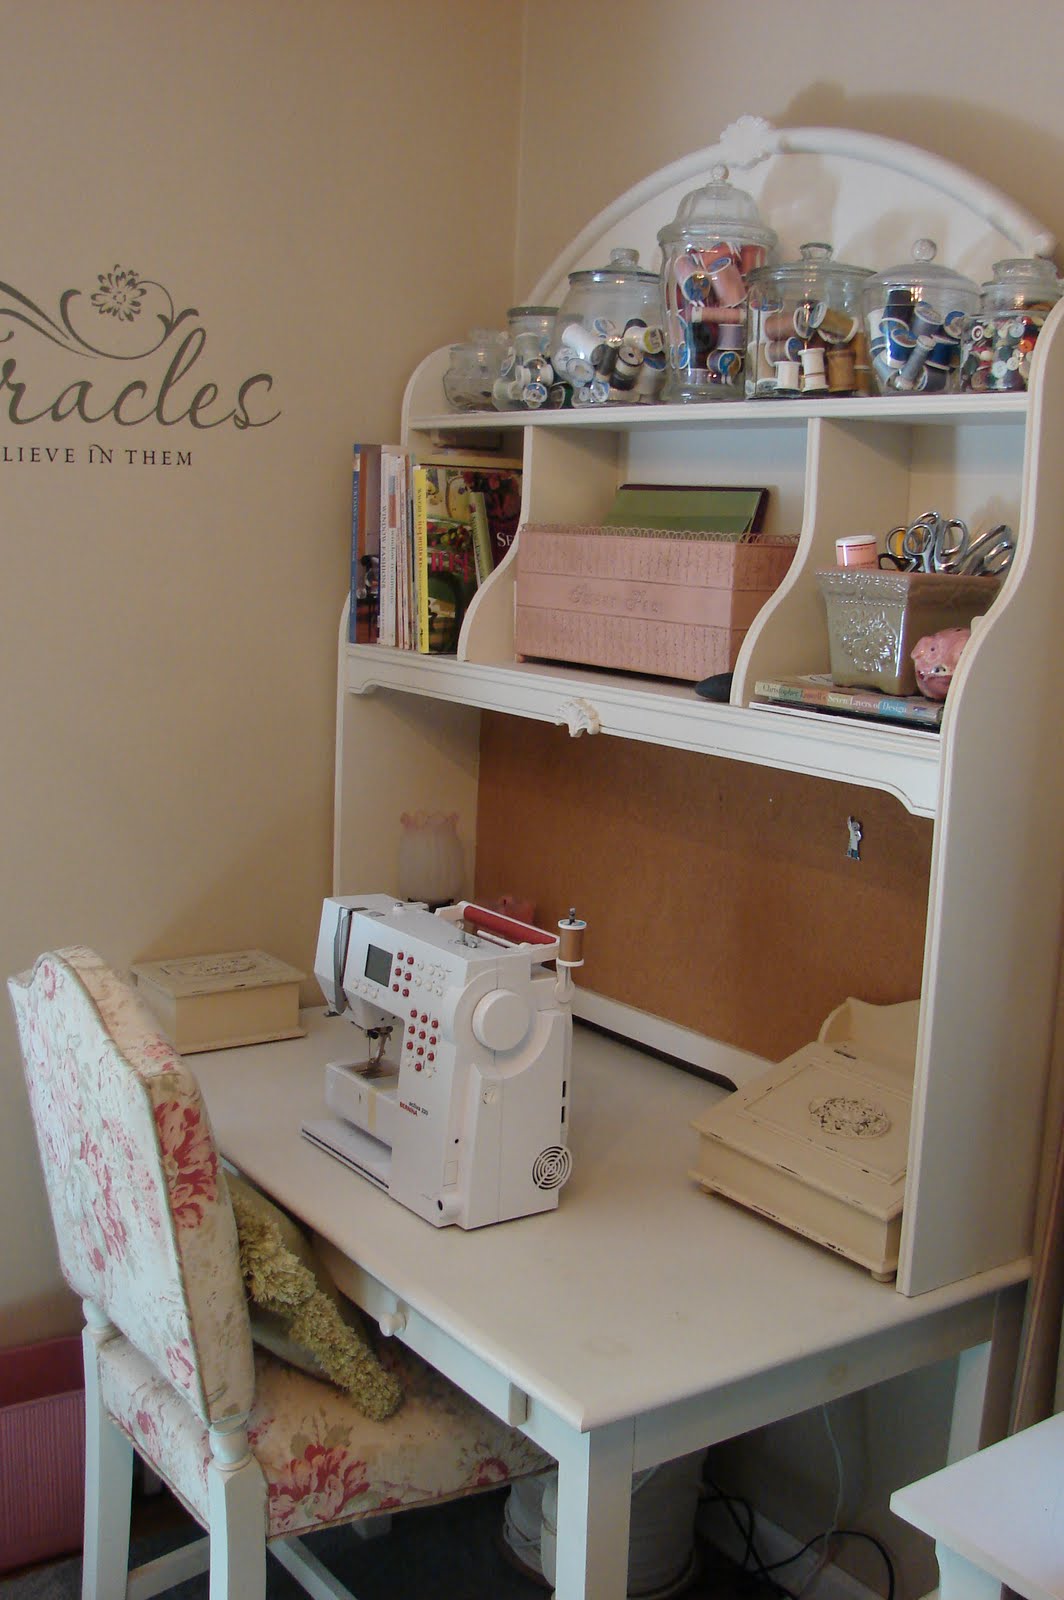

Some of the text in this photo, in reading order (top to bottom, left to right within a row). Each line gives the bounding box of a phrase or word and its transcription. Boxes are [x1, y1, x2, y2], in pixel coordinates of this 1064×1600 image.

[3, 444, 193, 466] LIEVE IN THEM
[827, 693, 849, 705] Seven
[849, 696, 872, 709] Layers
[872, 699, 881, 709] of
[882, 700, 908, 714] Design
[399, 1101, 418, 1117] BERNINA
